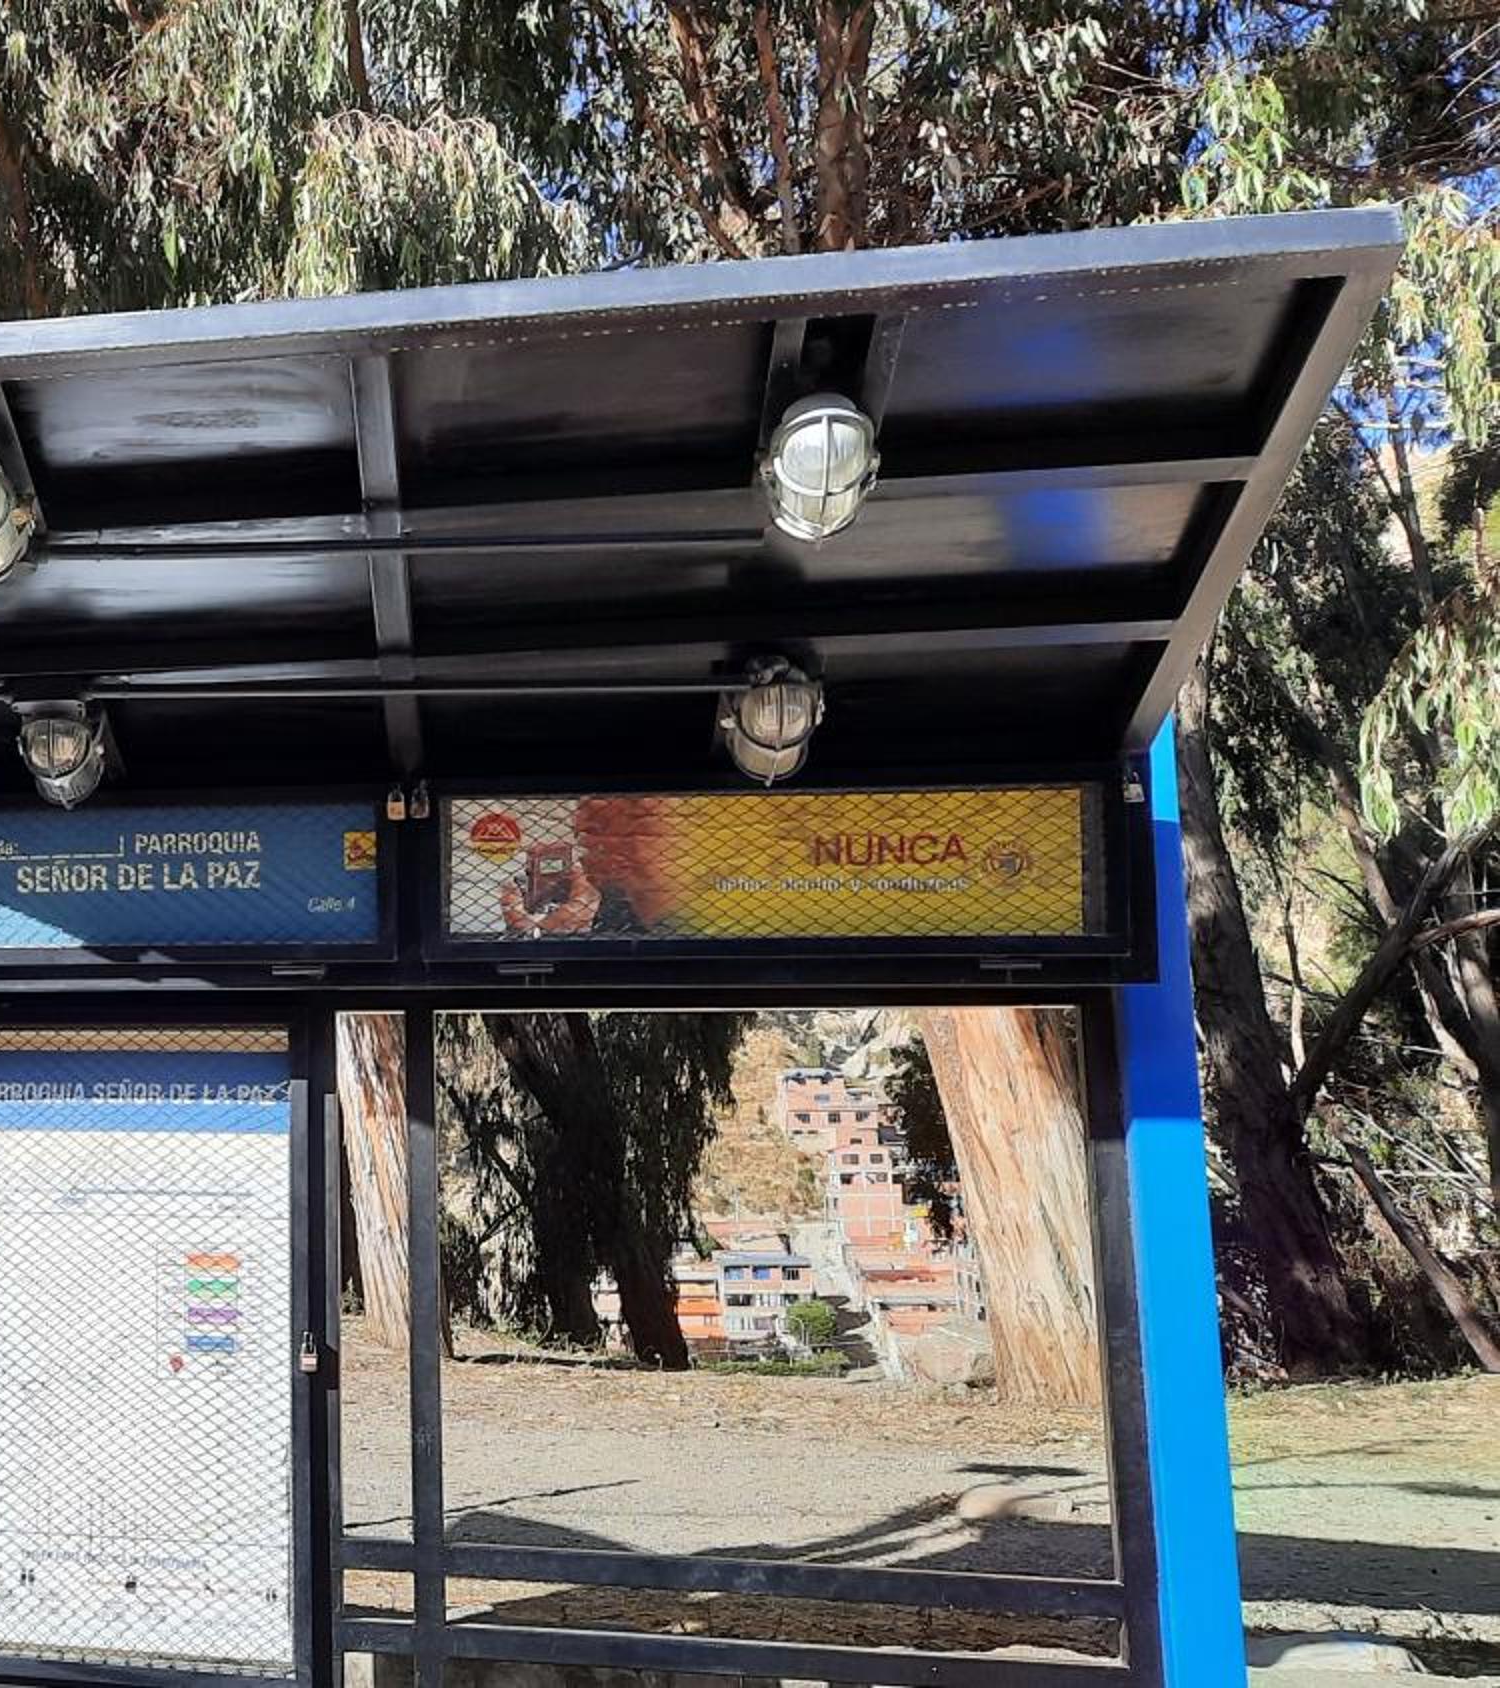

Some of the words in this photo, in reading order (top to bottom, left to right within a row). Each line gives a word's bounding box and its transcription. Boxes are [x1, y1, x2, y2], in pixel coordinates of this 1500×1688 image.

[134, 831, 261, 856] PARROQUIA
[811, 832, 969, 867] NUNCA
[16, 859, 108, 893] SEÑOR
[117, 863, 155, 891] DE
[163, 862, 199, 890] LA
[207, 860, 261, 889] PAZ
[93, 1079, 165, 1104] SEÑOR
[169, 1083, 197, 1105] DE
[203, 1084, 229, 1105] LA
[236, 1085, 278, 1106] PAZ
